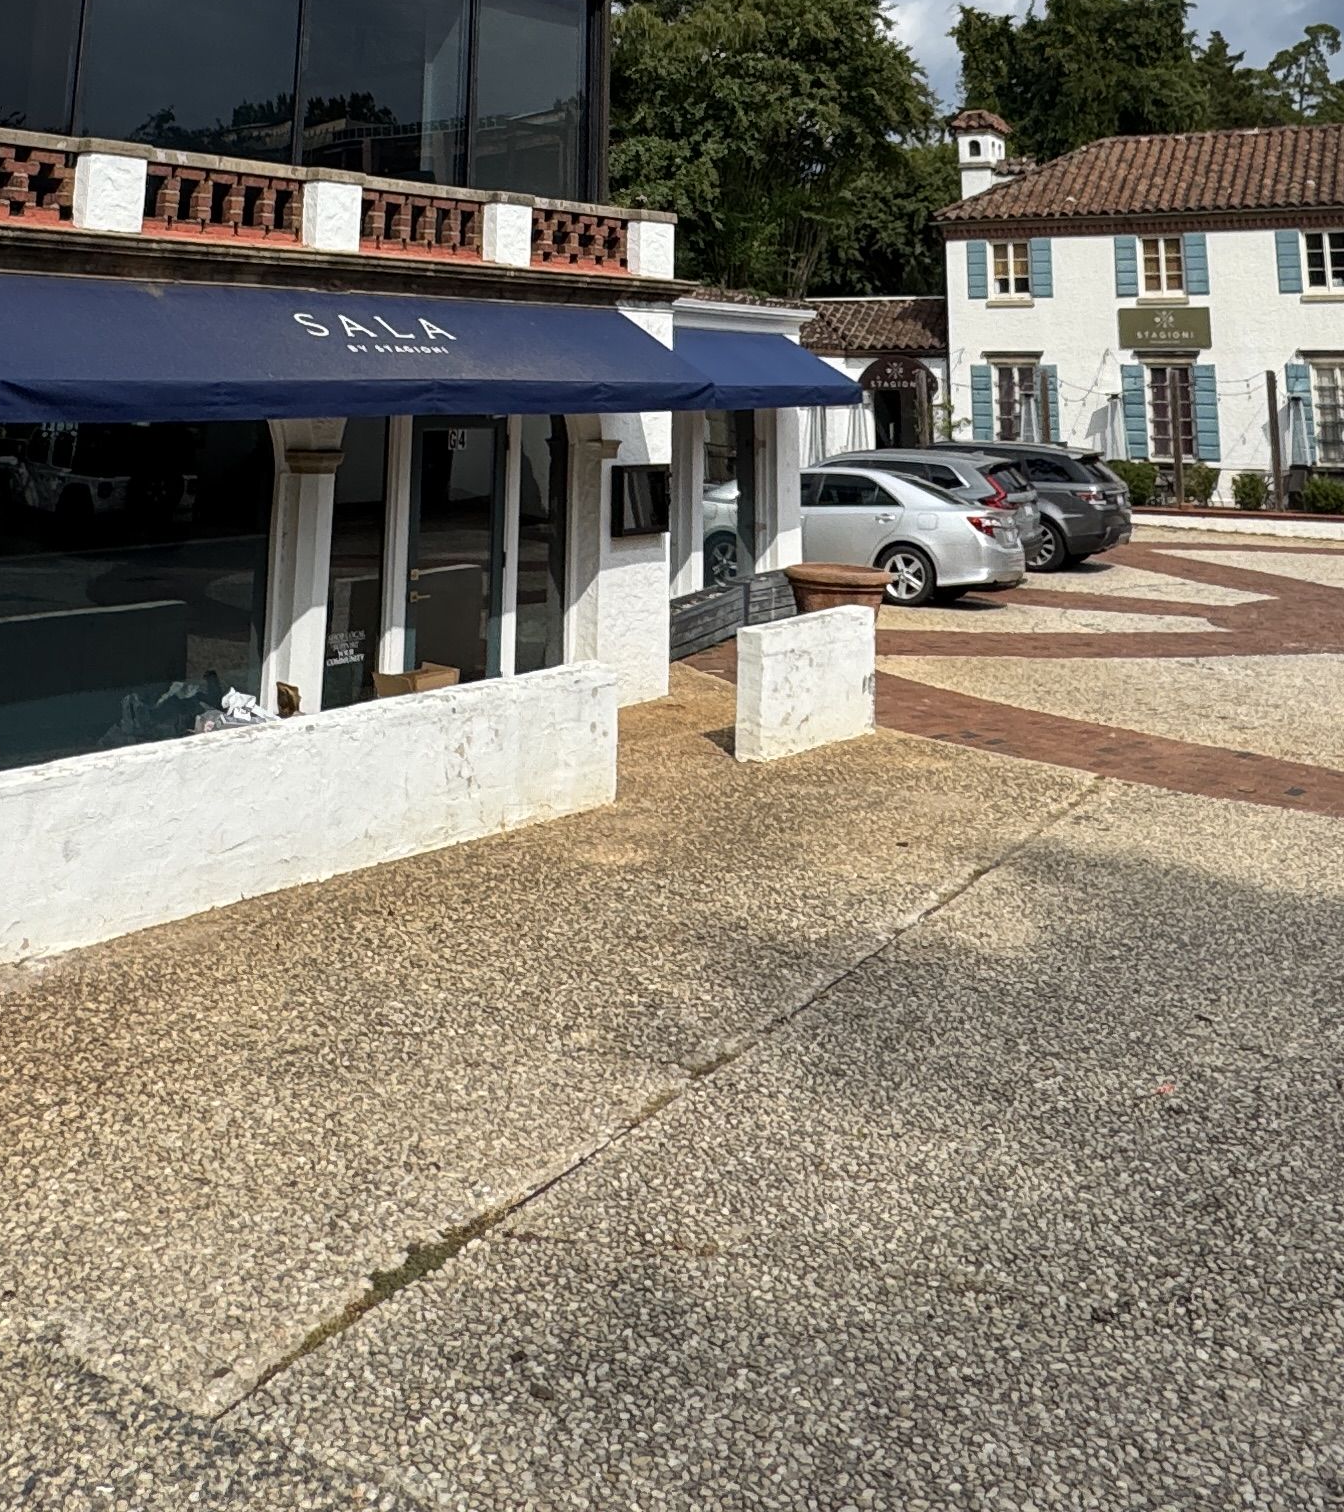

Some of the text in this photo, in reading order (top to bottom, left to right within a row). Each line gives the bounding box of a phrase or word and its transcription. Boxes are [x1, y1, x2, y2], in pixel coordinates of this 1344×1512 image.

[293, 312, 456, 340] SALA
[1136, 330, 1194, 339] STAGIONI
[374, 344, 449, 354] STAGIONI
[870, 380, 917, 388] STAGION
